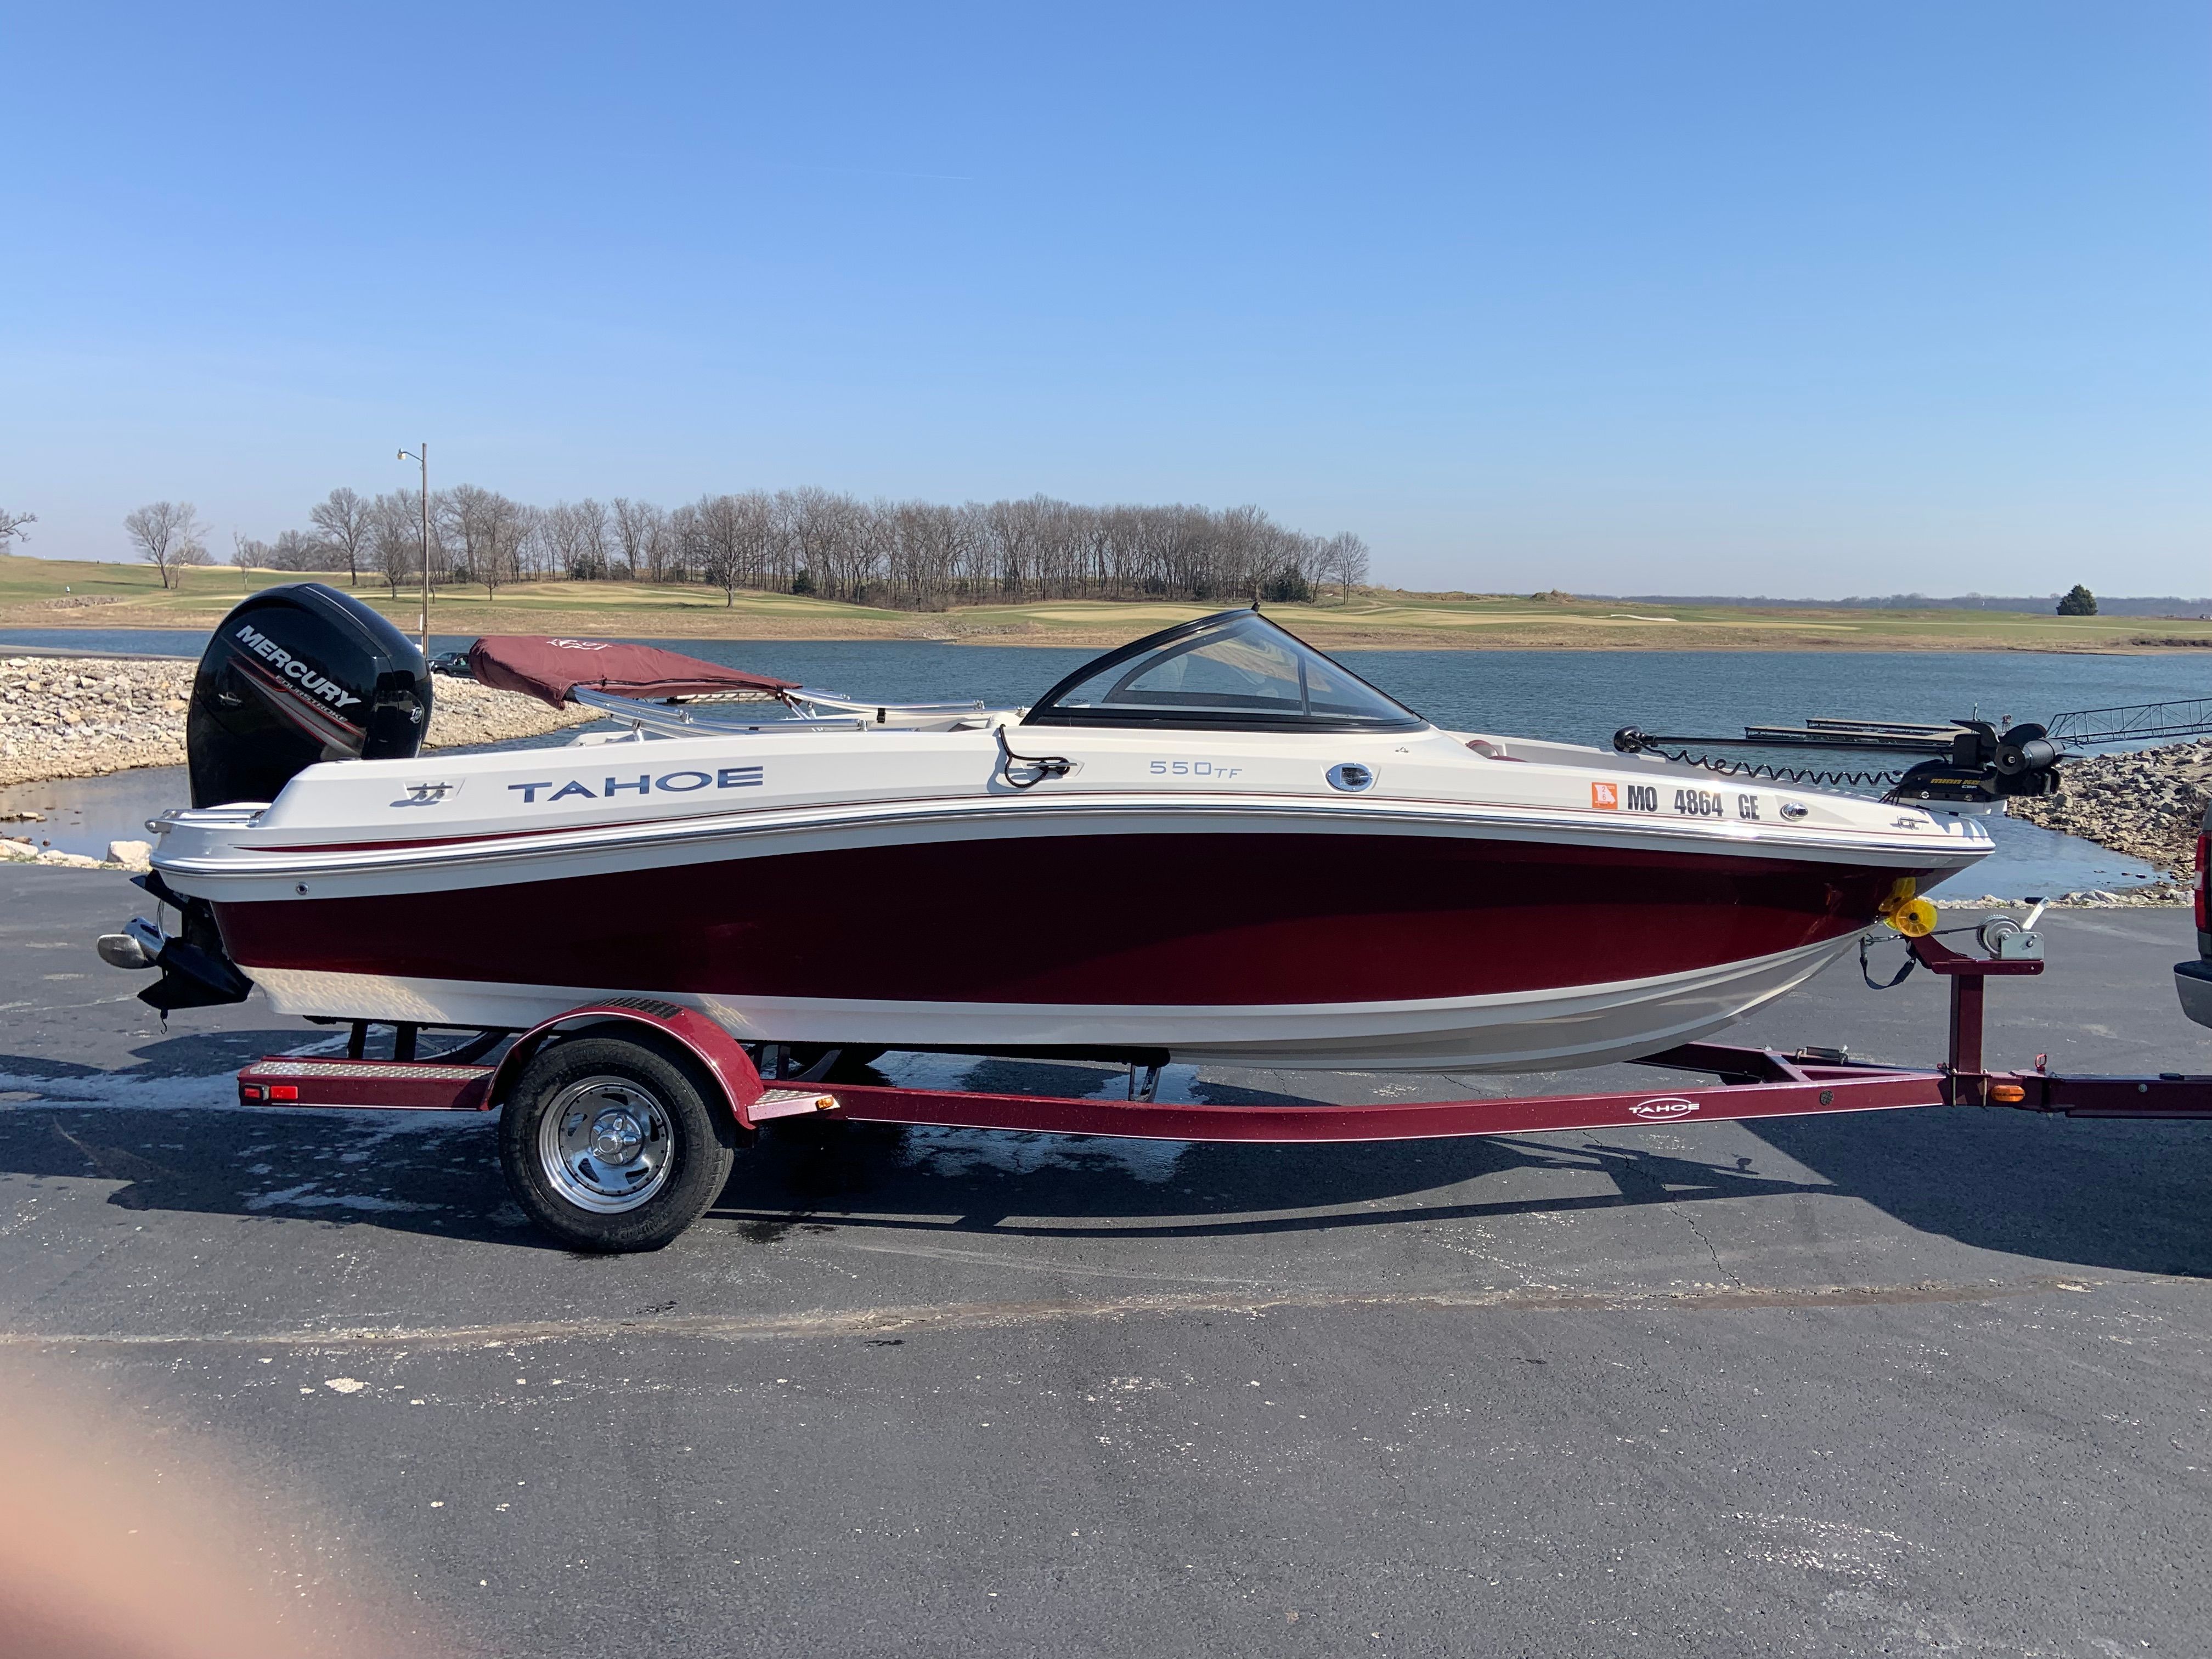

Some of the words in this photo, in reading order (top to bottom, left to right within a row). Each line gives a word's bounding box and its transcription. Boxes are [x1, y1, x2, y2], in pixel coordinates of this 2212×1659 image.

[236, 625, 362, 708] MERCURY
[275, 675, 348, 723] FOURSTROKE
[508, 766, 763, 803] TAHOE
[1628, 785, 1658, 812] MO
[1674, 789, 1724, 817] 4864
[1738, 794, 1760, 820] GE
[1629, 1103, 1700, 1114] TAHOE
